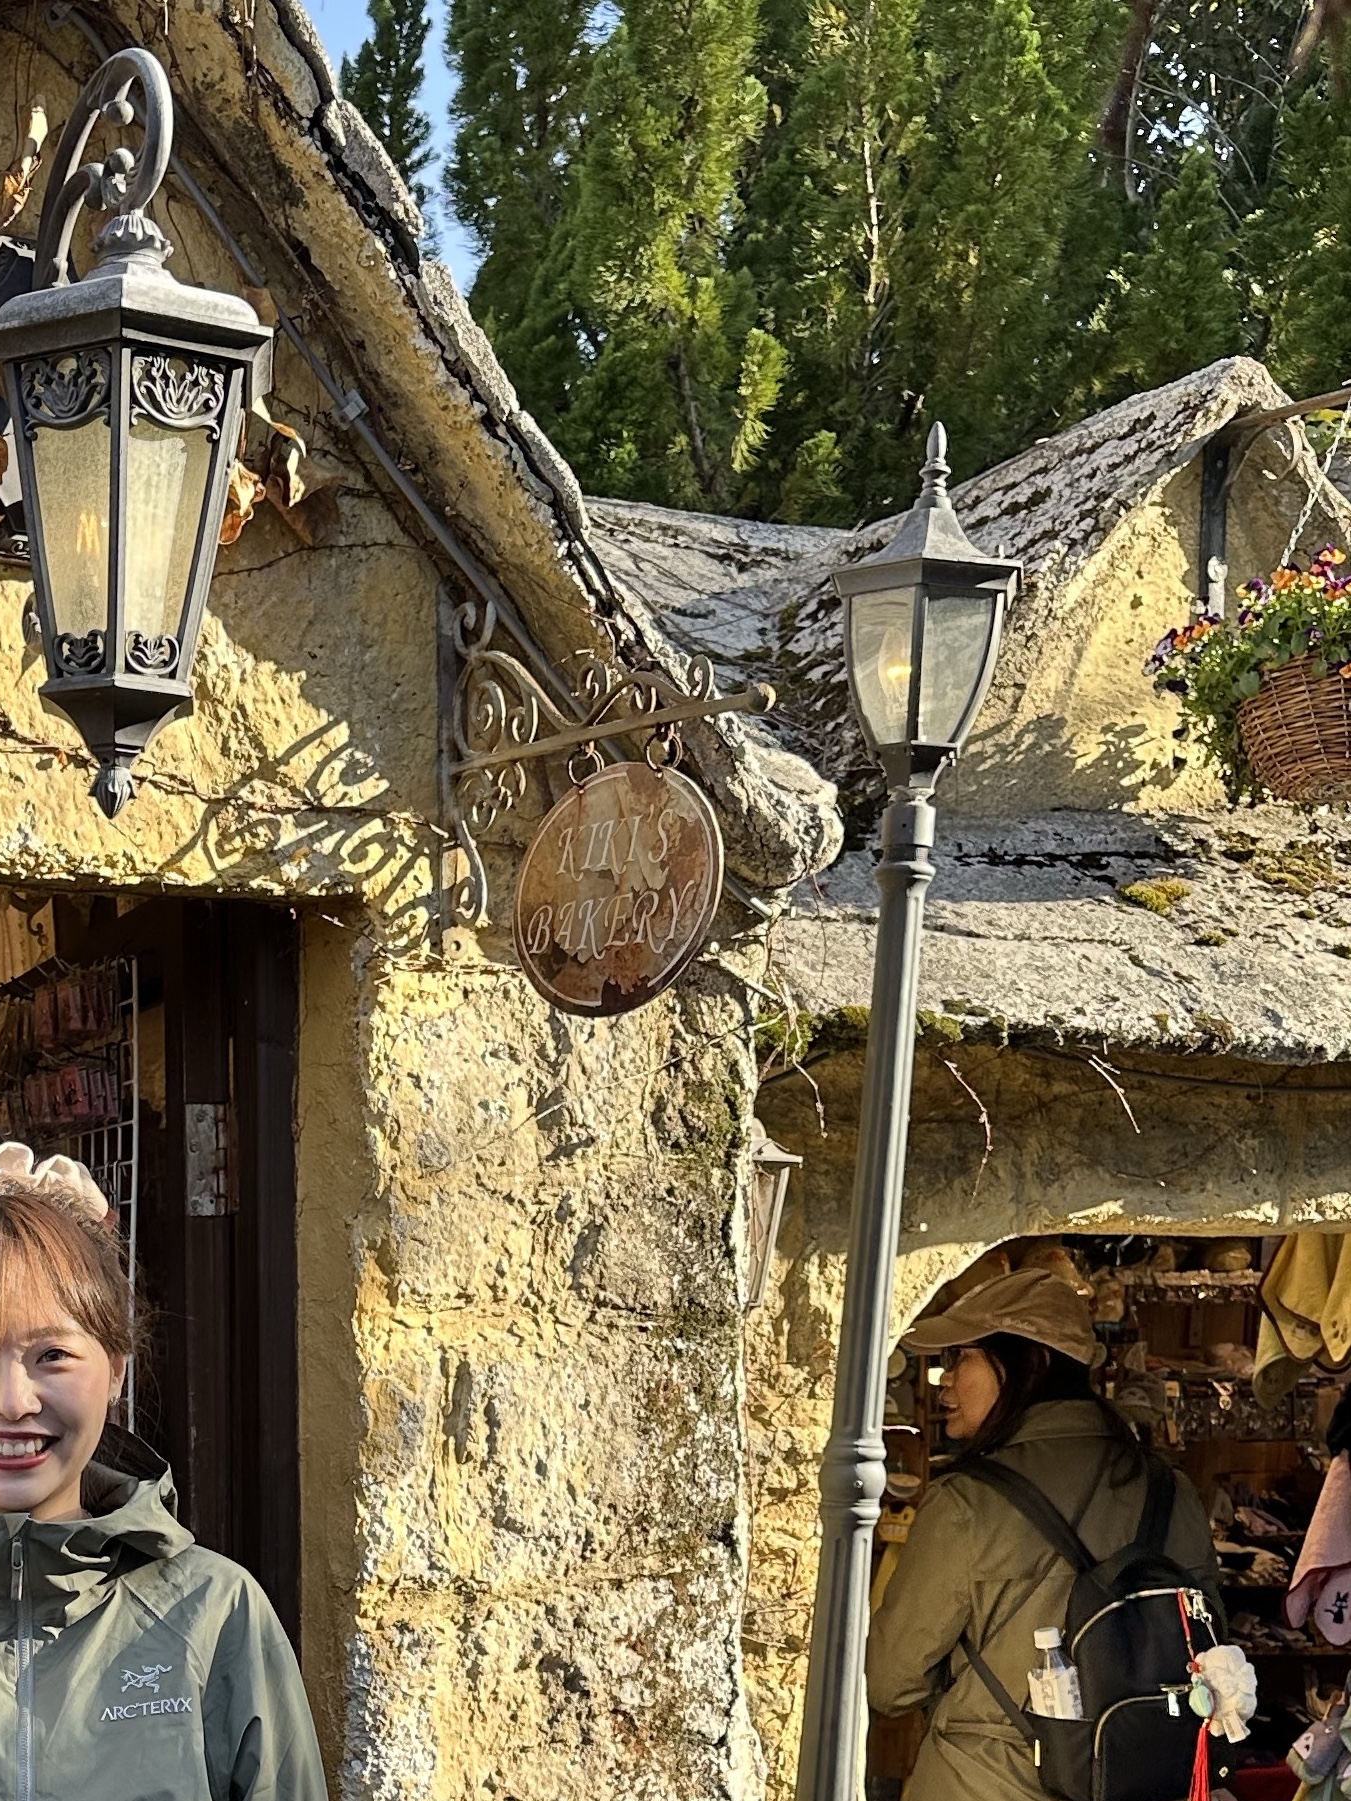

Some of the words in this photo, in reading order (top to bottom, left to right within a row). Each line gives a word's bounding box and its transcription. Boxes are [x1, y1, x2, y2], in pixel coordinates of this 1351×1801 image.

[556, 803, 674, 882] KIKI'S
[527, 880, 695, 960] BAKERY
[100, 1697, 193, 1721] ARC'TERYX
